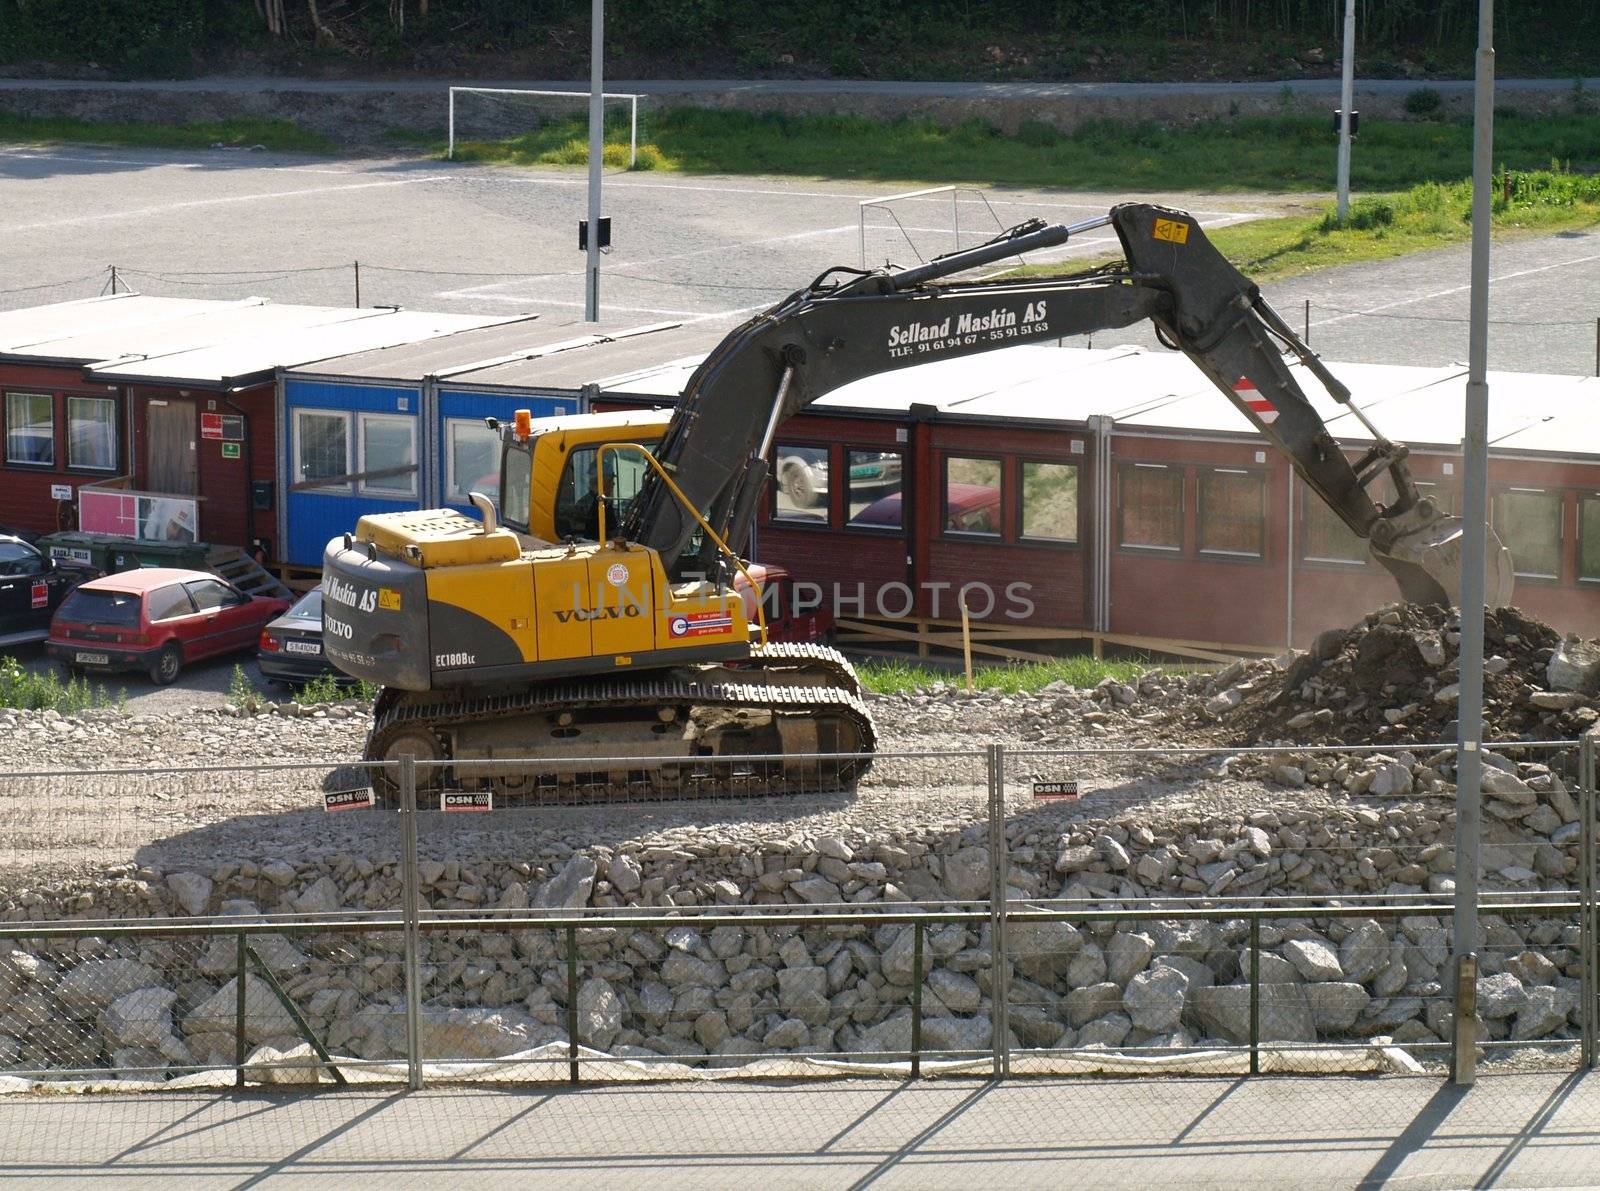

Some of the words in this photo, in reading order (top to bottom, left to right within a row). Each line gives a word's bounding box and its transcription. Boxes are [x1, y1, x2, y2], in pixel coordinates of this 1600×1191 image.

[888, 316, 950, 347] Selland
[956, 308, 1016, 335] Maskin
[1023, 300, 1047, 323] AS
[888, 346, 913, 358] TLF:
[918, 342, 931, 353] 91
[933, 340, 945, 350] 61
[947, 337, 961, 348] 94
[964, 334, 977, 345] 67
[990, 330, 1004, 340] 55
[1006, 327, 1018, 338] 91
[1020, 324, 1033, 335] 51
[330, 577, 357, 608] Maskin
[358, 589, 377, 613] AS
[324, 612, 353, 640] VOLVO
[552, 604, 640, 624] VOLVO
[326, 793, 354, 805] OSN
[446, 795, 473, 804] OSN
[1034, 784, 1061, 793] OSN
